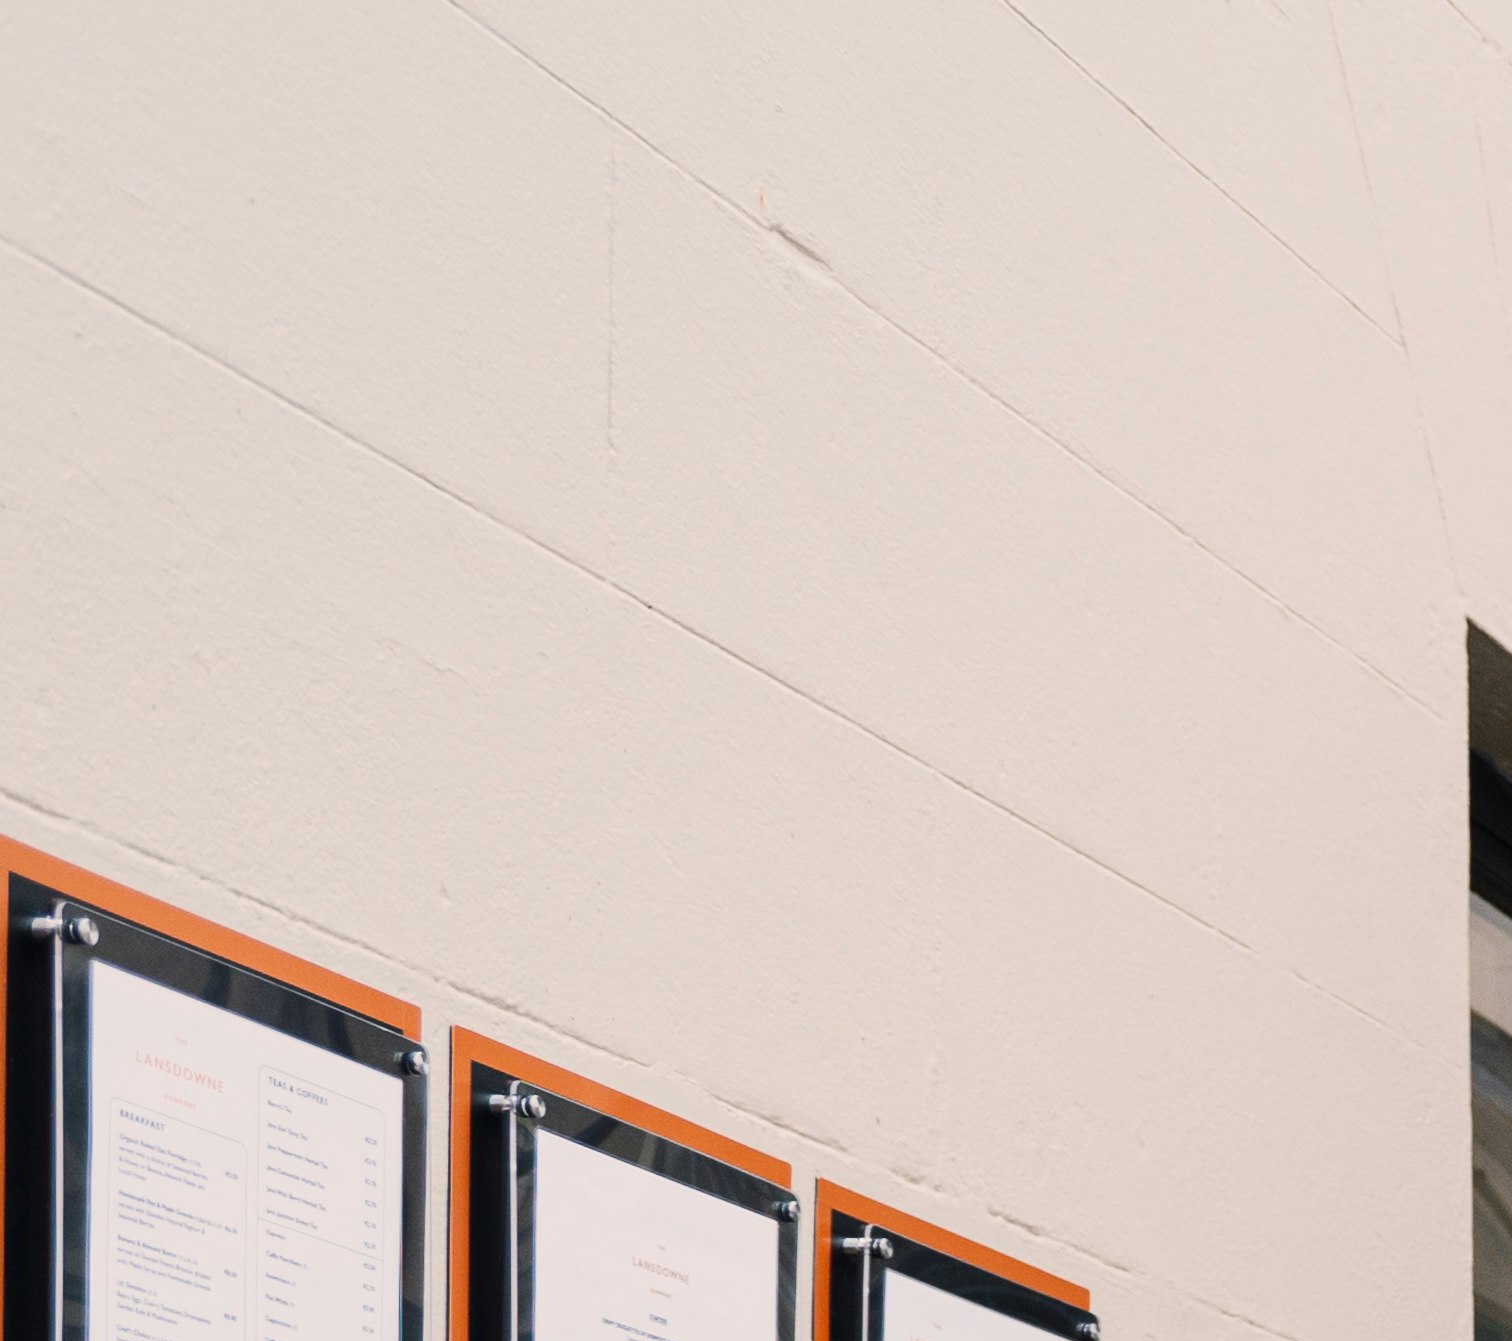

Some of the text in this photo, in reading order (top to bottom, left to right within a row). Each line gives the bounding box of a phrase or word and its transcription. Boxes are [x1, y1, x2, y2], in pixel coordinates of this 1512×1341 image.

[135, 1049, 224, 1094] LANSDOWNE
[268, 1076, 286, 1090] TEAS
[296, 1087, 328, 1106] COFFEES
[120, 1109, 164, 1131] BREAKFAST
[631, 1255, 689, 1286] LANSDOWNE
